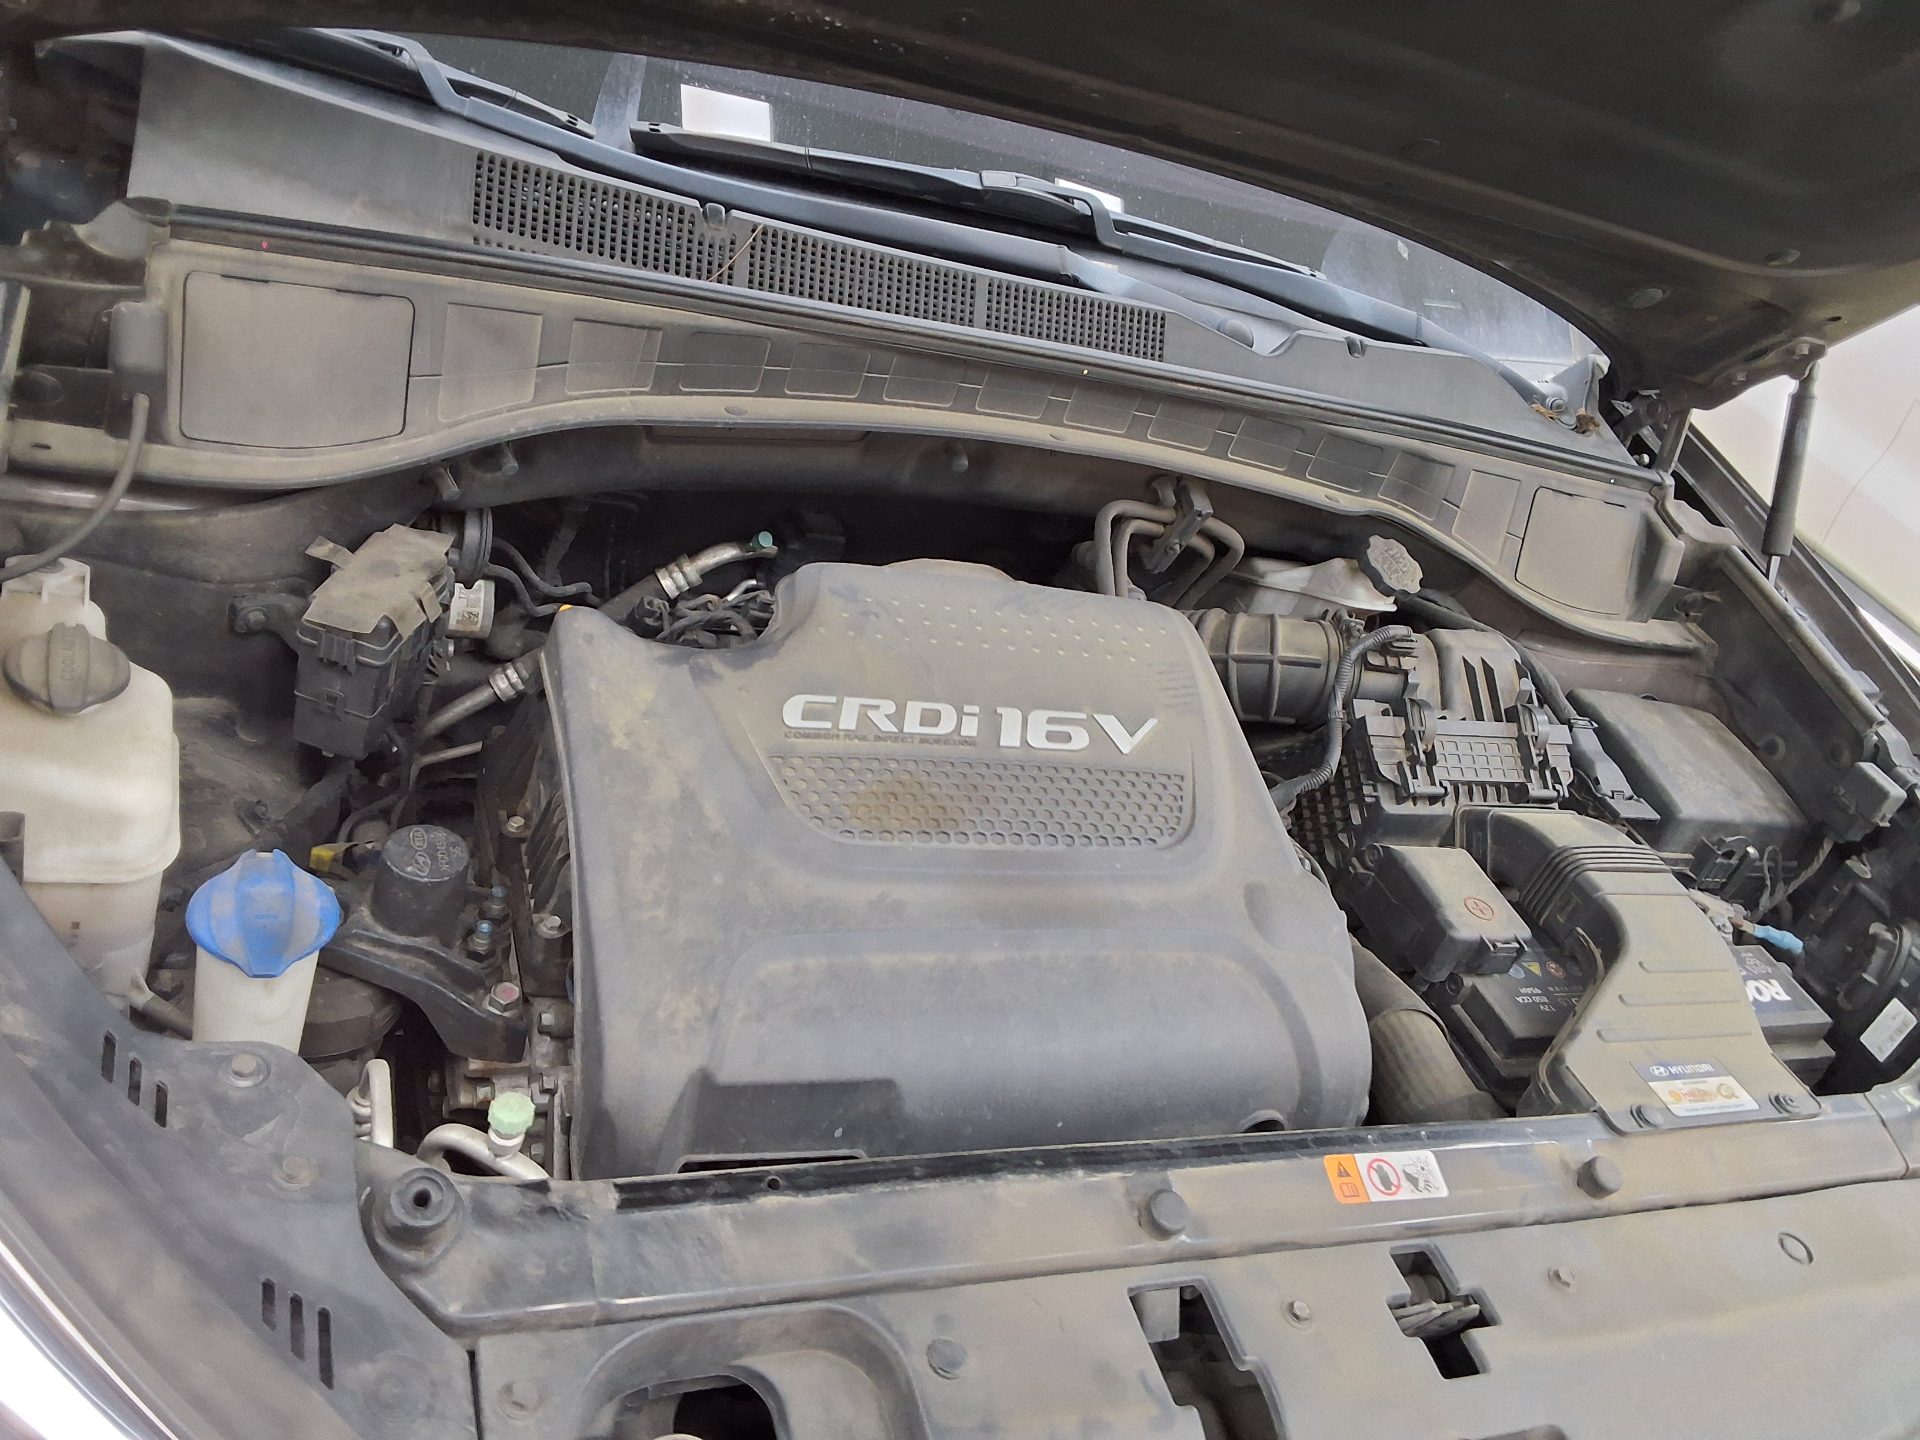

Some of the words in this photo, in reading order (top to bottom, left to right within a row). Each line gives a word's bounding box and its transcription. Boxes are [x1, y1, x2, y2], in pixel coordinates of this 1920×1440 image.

[782, 694, 980, 737] CRDi
[996, 706, 1159, 755] 16V
[1745, 978, 1792, 1003] RO
[1667, 1063, 1715, 1075] HYUNDAI
